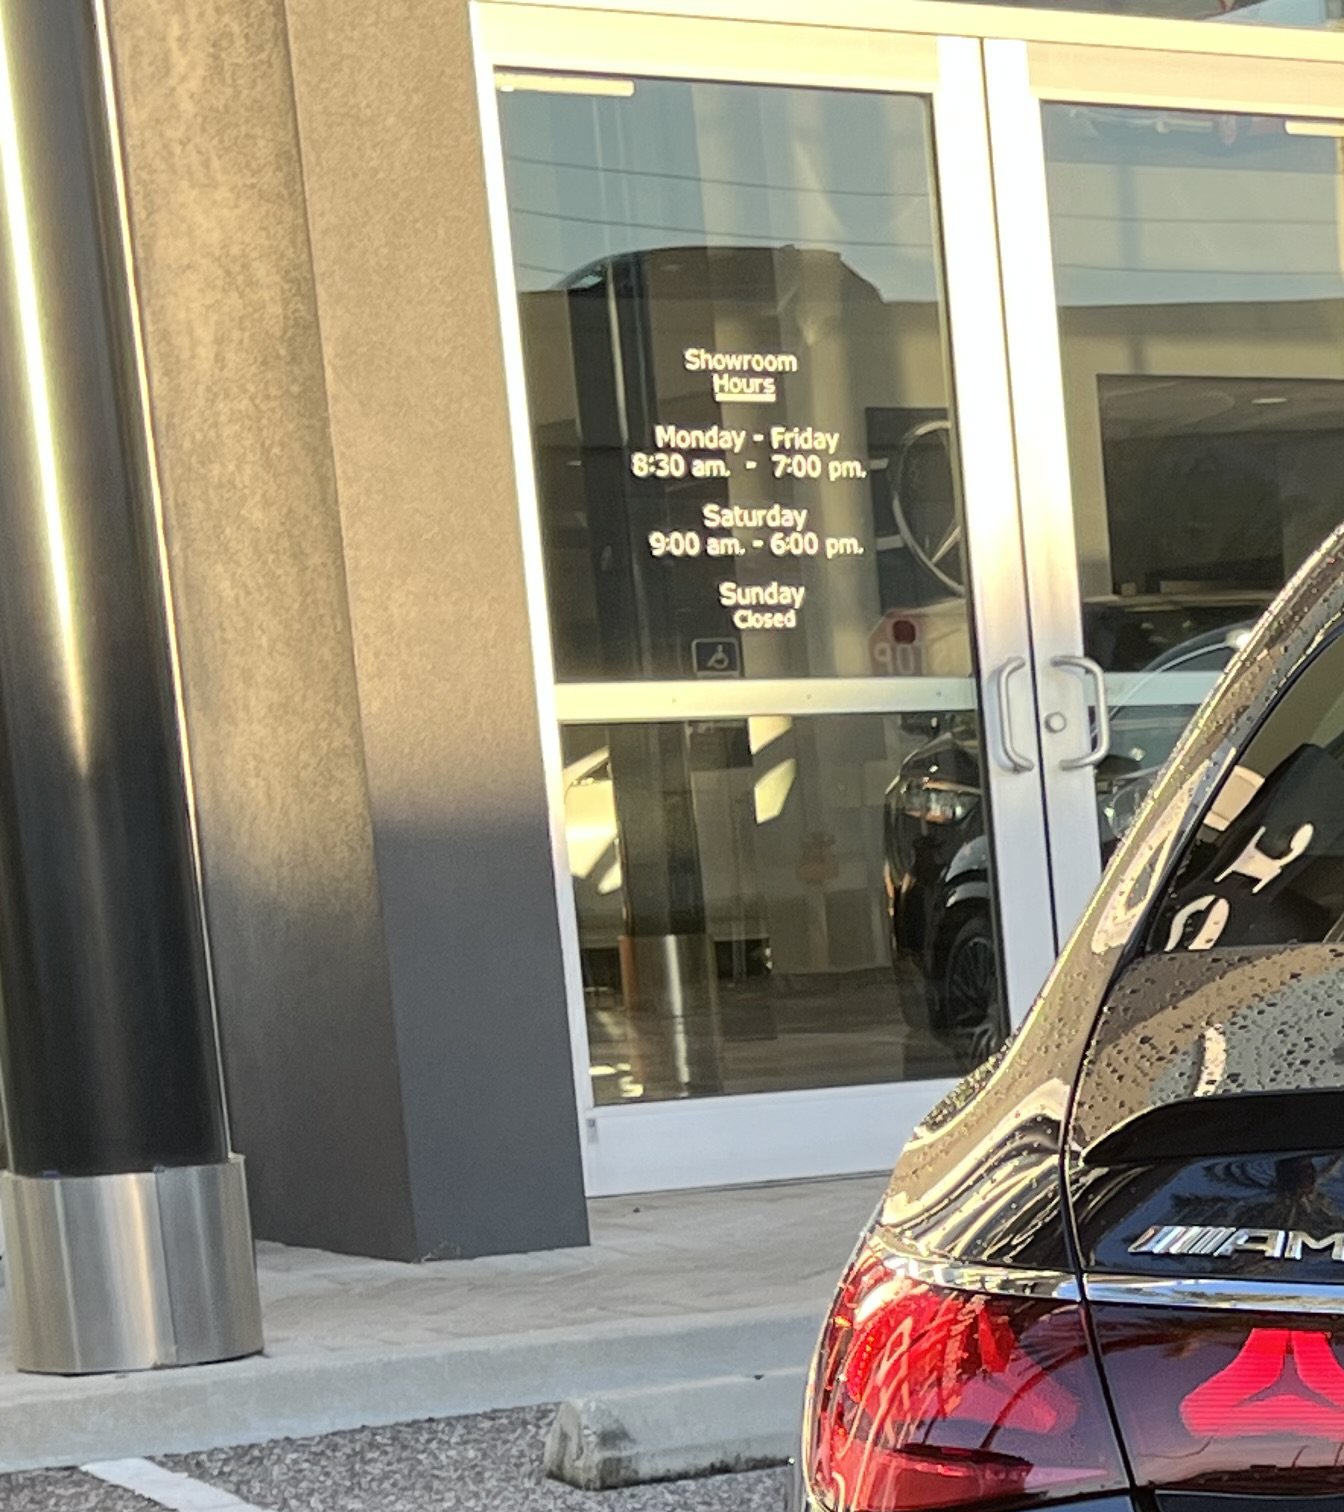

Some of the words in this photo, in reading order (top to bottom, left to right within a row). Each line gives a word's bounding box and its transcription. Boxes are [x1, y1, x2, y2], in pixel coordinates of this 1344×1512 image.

[684, 347, 798, 372] Showroom
[712, 373, 776, 396] Hours
[654, 424, 747, 452] Monday
[770, 426, 840, 452] Friday
[631, 452, 685, 478] 8:30
[691, 458, 731, 477] am.
[771, 453, 822, 479] 7:00
[827, 458, 868, 482] pm.
[702, 503, 808, 532] Saturday
[648, 531, 701, 556] 9:00
[706, 537, 746, 556] am.
[769, 530, 819, 556] 6:00
[824, 537, 864, 560] pm.
[719, 581, 805, 609] Sunday
[733, 608, 797, 630] Closed
